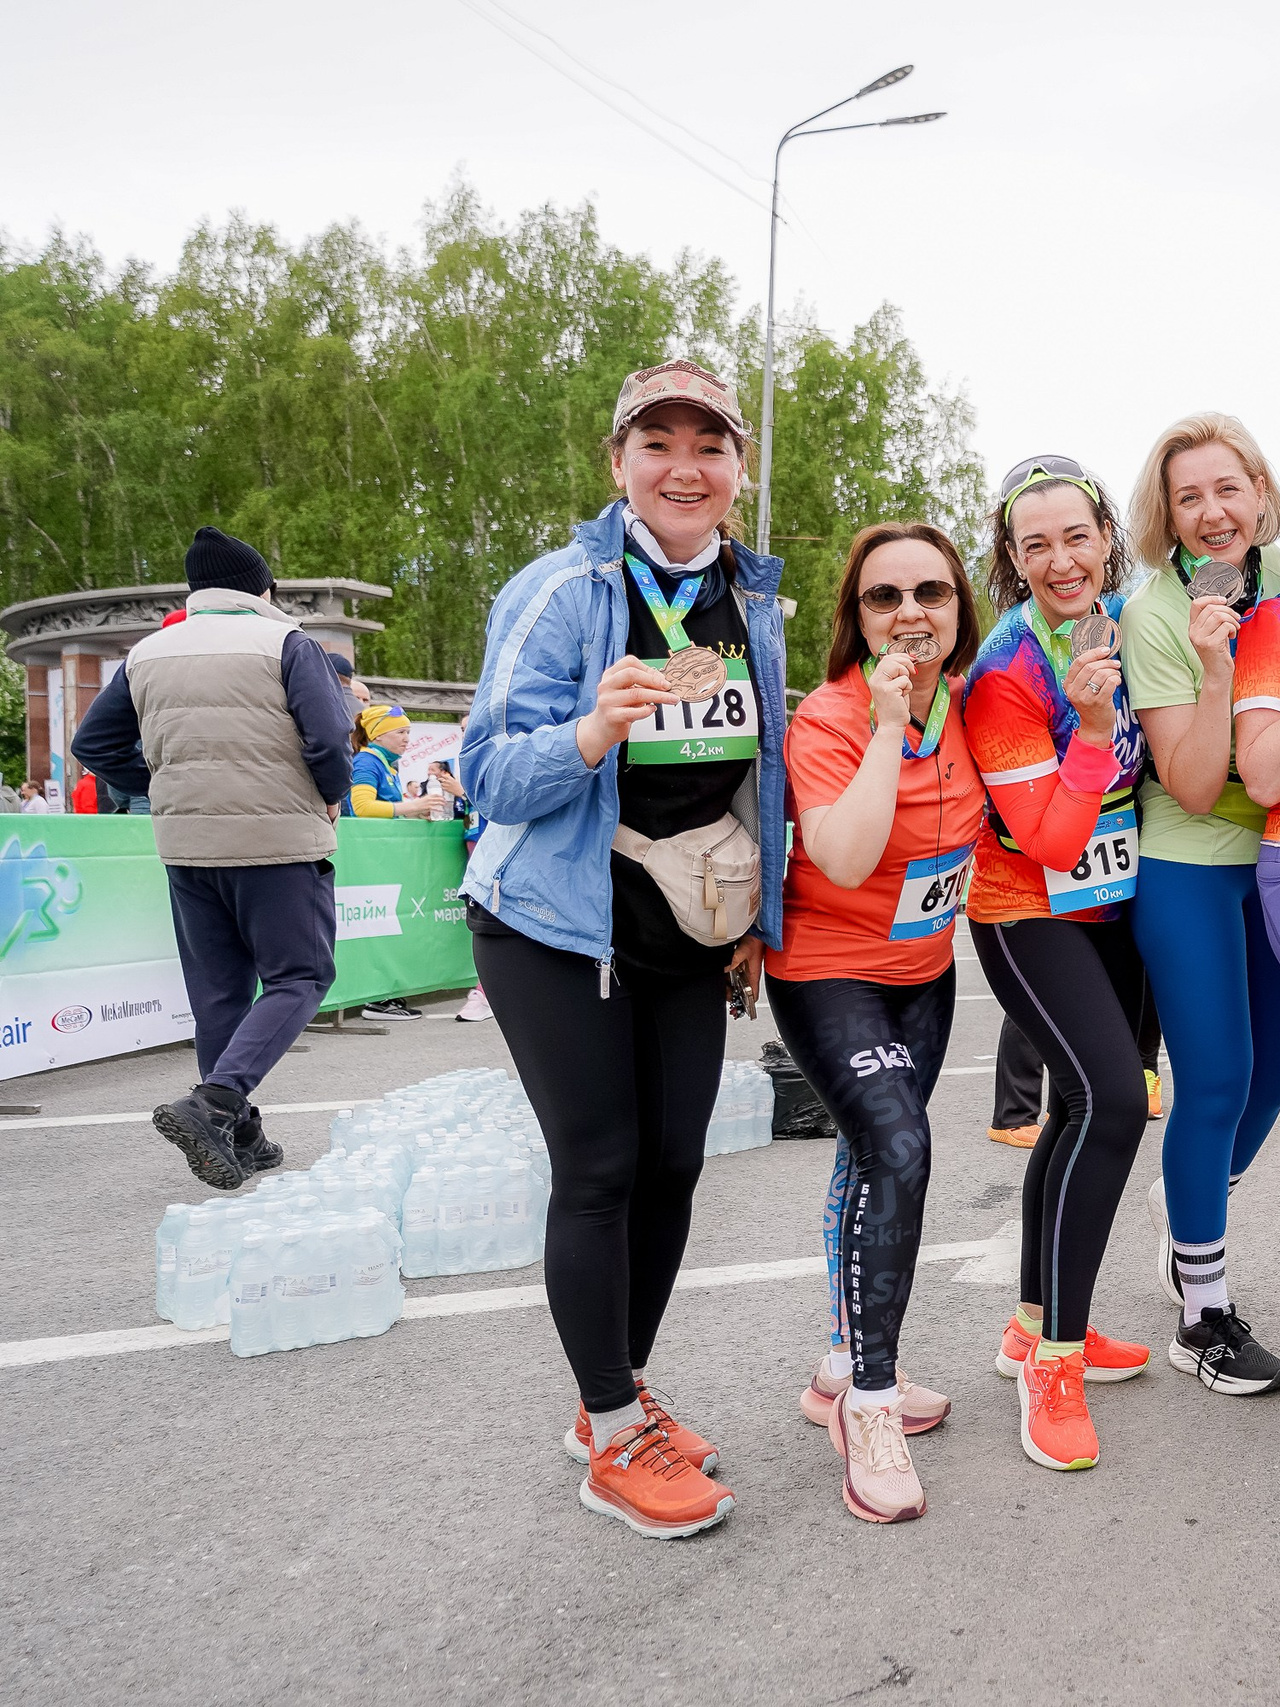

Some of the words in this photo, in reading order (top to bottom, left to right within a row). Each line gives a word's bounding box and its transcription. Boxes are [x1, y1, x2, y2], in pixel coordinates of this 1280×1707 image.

[653, 688, 746, 731] 1128
[1070, 837, 1131, 881] 815
[921, 865, 967, 912] 670
[1093, 887, 1109, 902] 10
[434, 906, 466, 929] мара
[932, 918, 942, 931] 10
